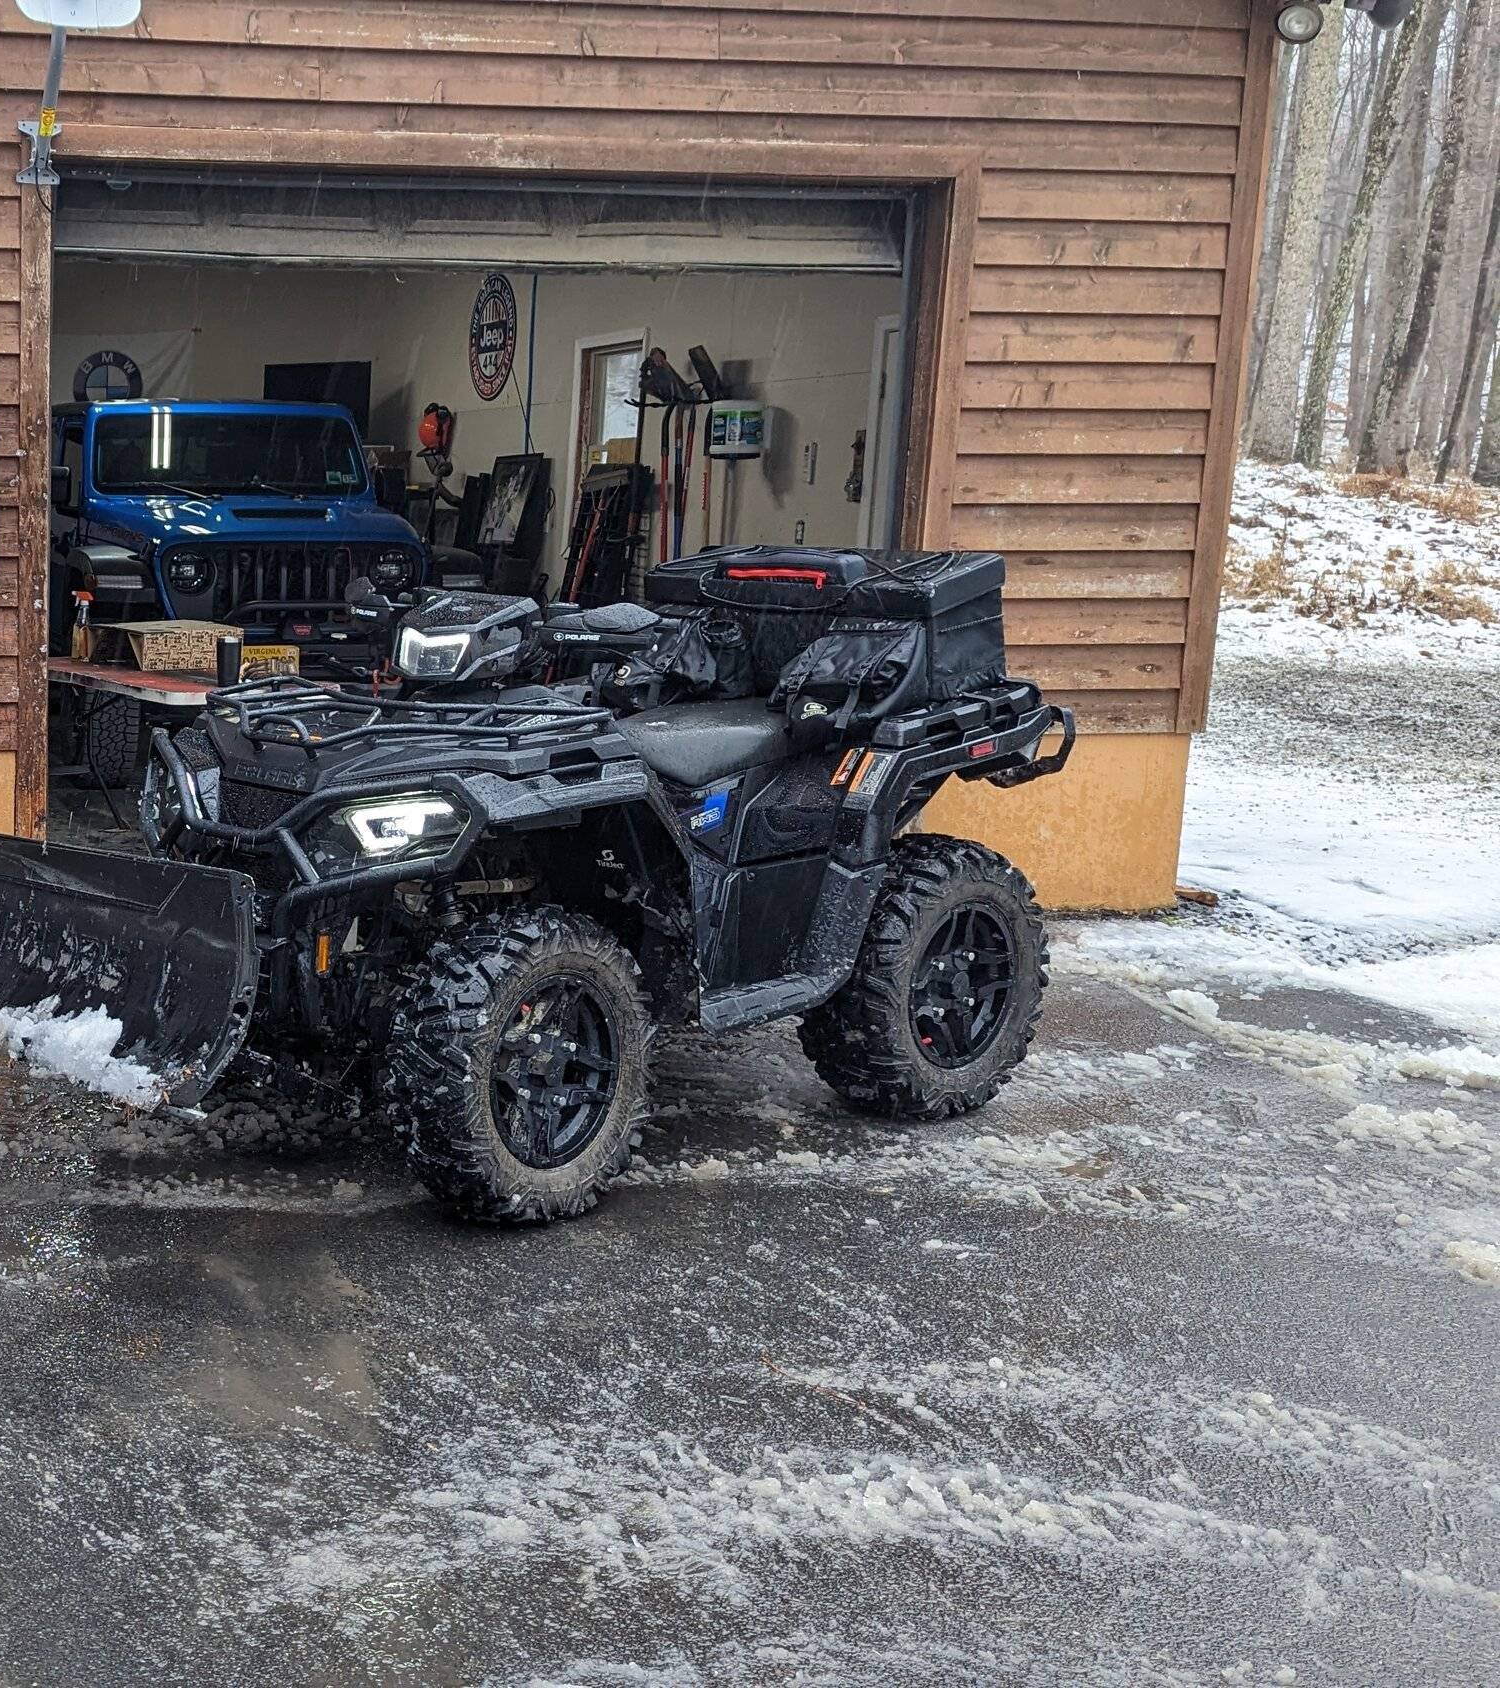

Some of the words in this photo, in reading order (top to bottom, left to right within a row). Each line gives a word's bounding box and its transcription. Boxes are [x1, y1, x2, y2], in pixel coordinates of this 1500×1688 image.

[480, 325, 504, 349] Jeep
[80, 352, 136, 374] BMW
[564, 633, 601, 641] POLARIS
